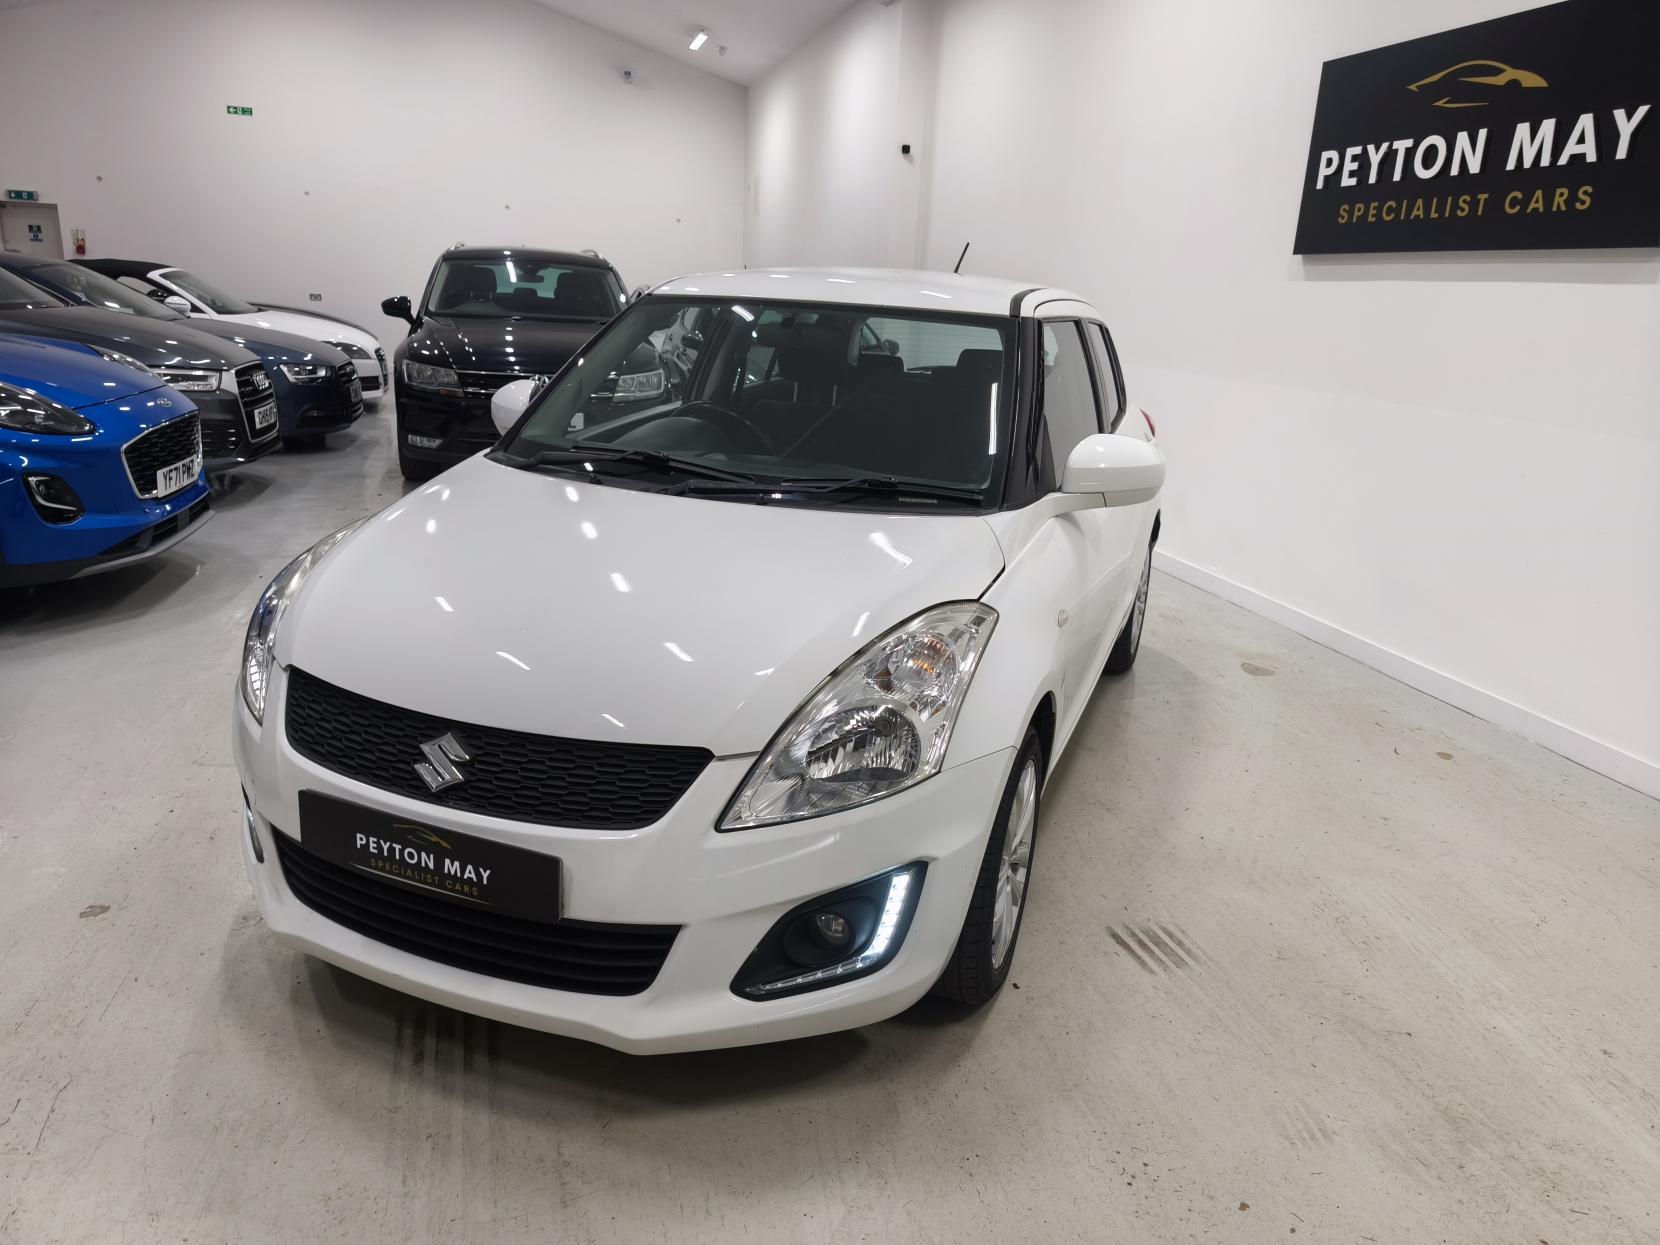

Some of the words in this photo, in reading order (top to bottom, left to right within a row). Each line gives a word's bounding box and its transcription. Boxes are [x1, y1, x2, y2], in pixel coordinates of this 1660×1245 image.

[1316, 127, 1488, 190] PEYTON
[1505, 104, 1651, 172] MAY
[1337, 193, 1489, 224] SPECIALIST
[1503, 185, 1594, 215] CARS
[162, 465, 181, 491] YF71
[356, 832, 435, 870] PEYTON
[444, 858, 491, 885] MAY
[369, 857, 440, 885] SPECIALIST
[445, 879, 479, 896] CARS
